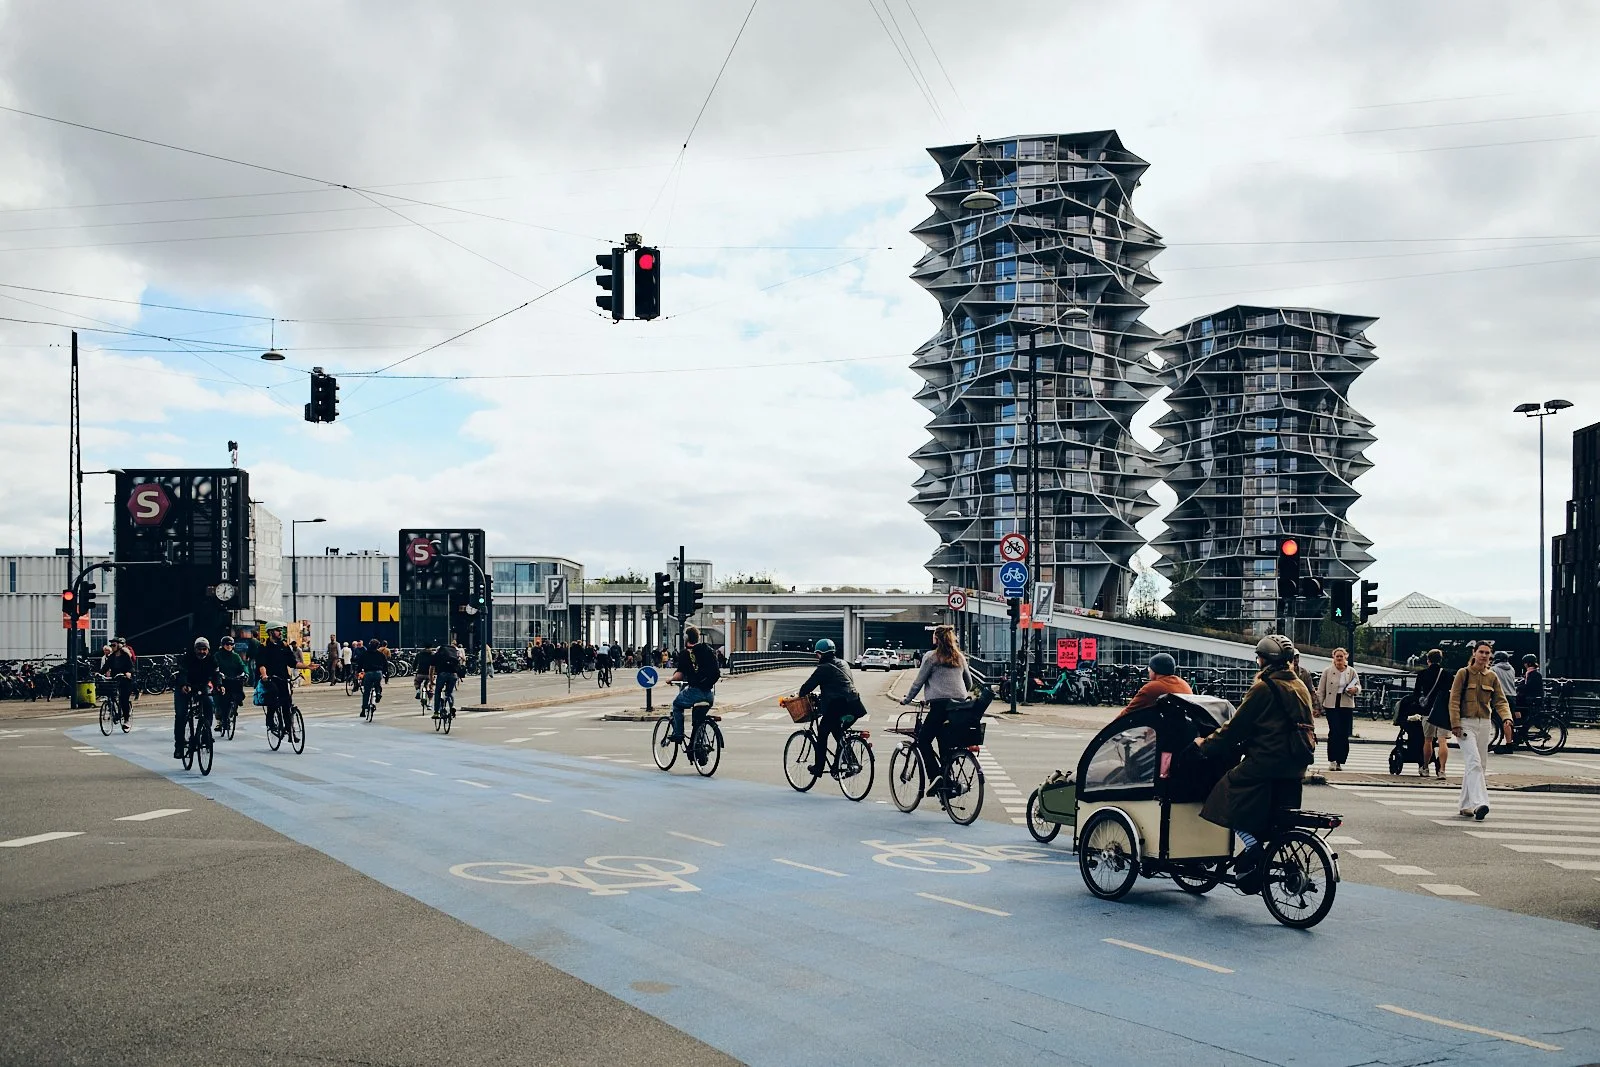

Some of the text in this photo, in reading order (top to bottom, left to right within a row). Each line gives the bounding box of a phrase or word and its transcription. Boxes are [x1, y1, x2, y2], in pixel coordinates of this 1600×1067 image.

[136, 490, 160, 518] S
[414, 544, 429, 561] S
[550, 579, 560, 593] P
[1040, 587, 1049, 602] P
